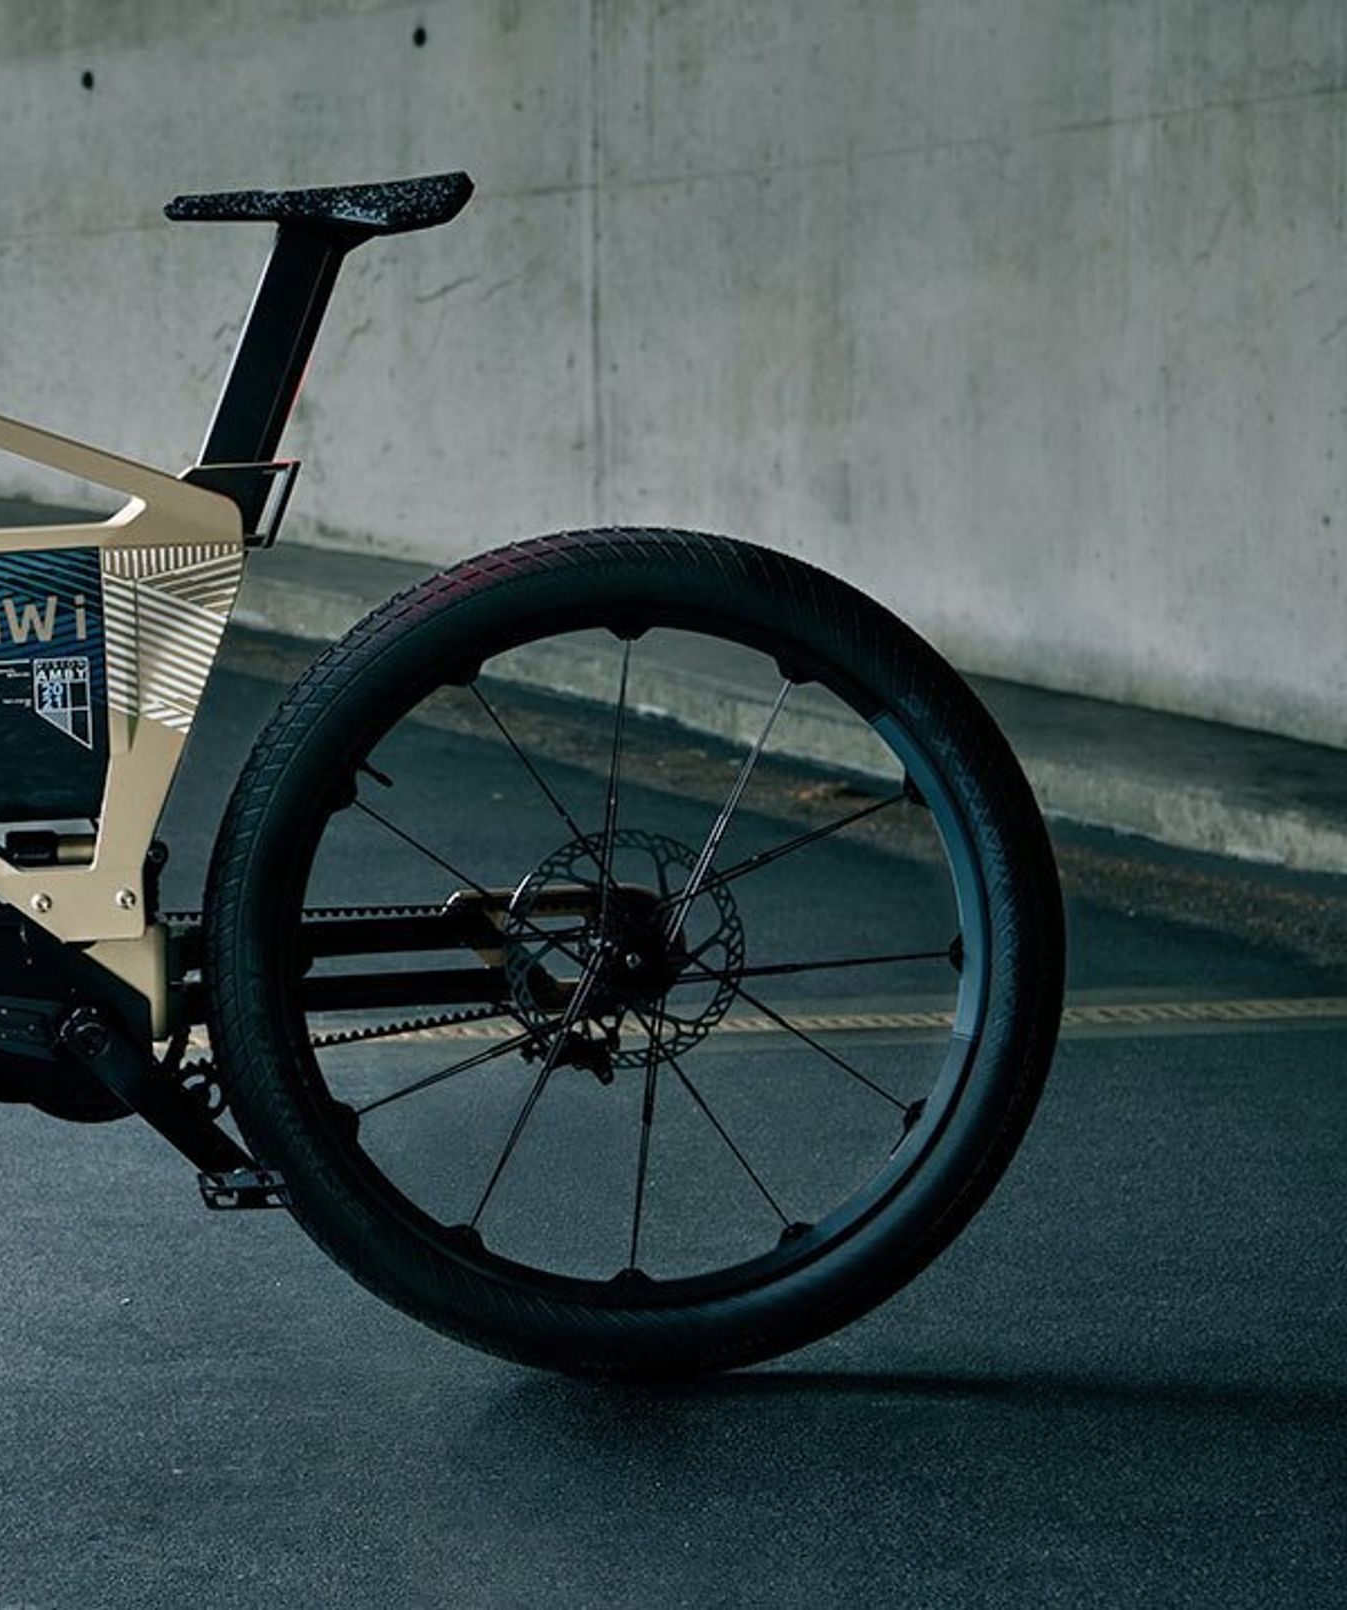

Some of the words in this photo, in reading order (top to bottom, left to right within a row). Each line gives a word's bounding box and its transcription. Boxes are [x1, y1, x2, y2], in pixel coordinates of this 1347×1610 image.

[74, 594, 87, 640] i
[42, 682, 63, 696] 20
[41, 696, 63, 711] 21
